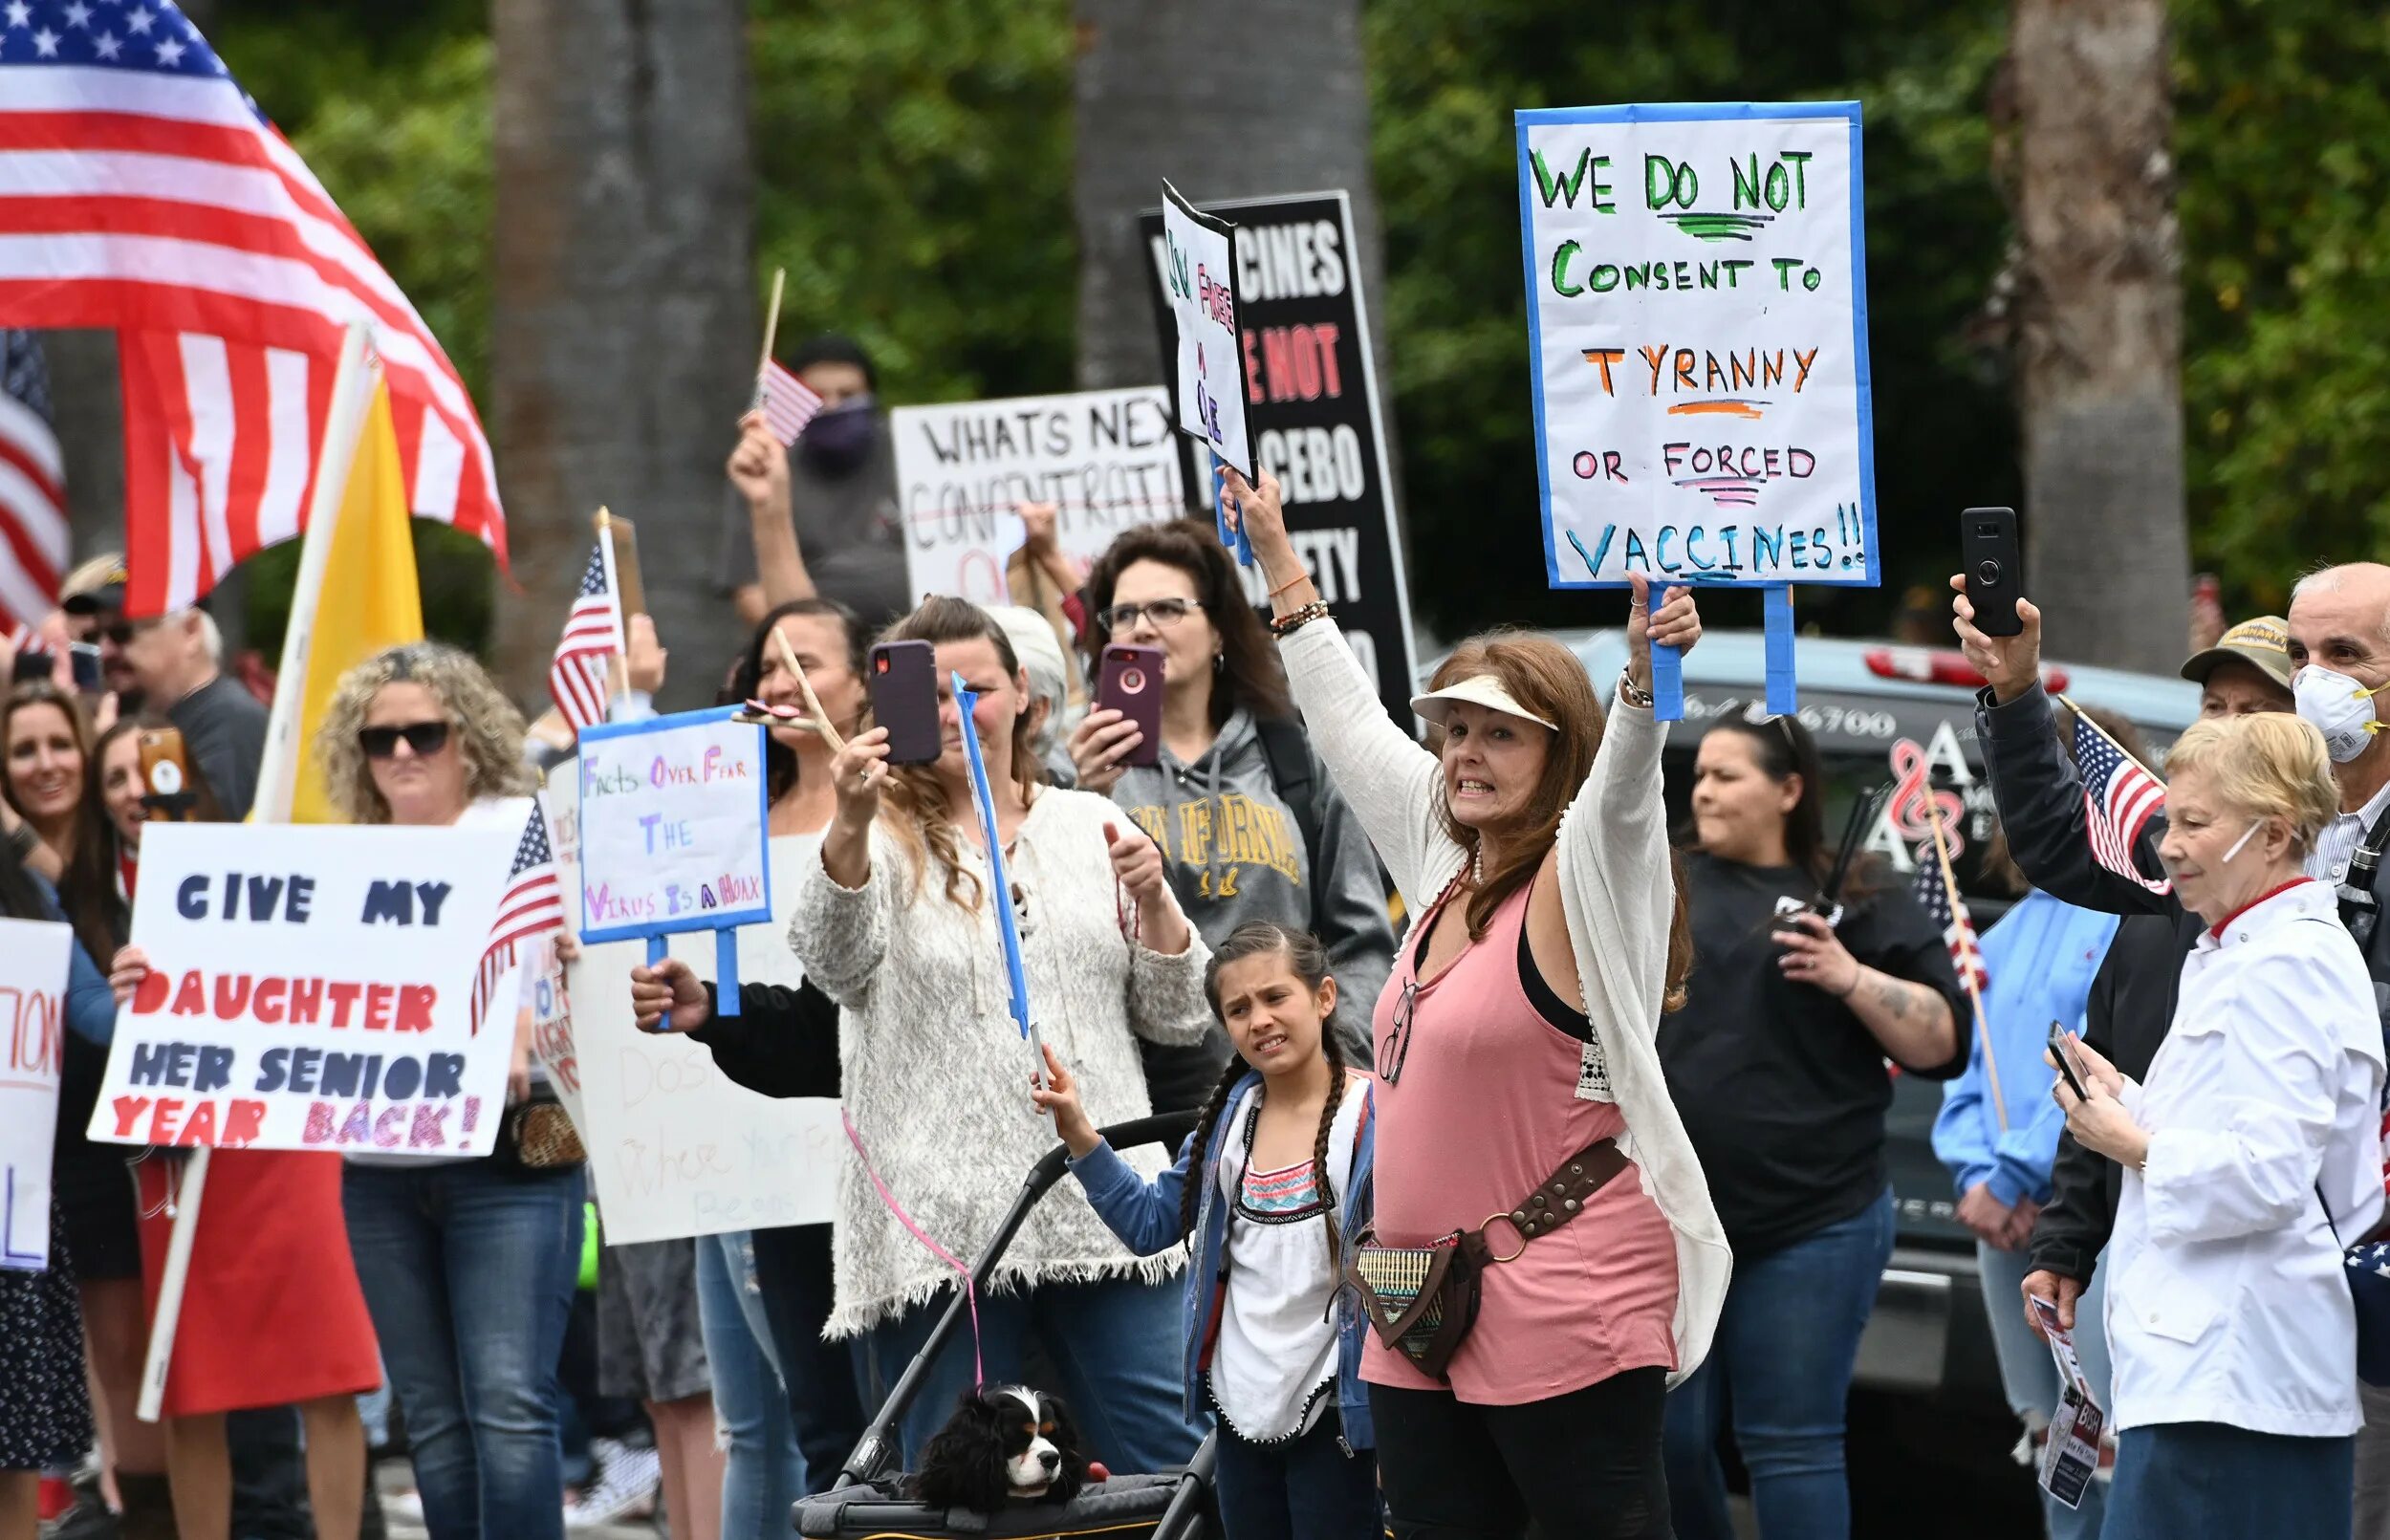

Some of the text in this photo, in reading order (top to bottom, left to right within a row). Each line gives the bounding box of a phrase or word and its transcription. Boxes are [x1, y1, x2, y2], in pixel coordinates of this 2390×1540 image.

[1529, 147, 1813, 214] WE DO NOT
[1552, 239, 1755, 297] CONSENT
[1261, 321, 1342, 403] NOT
[1581, 343, 1818, 398] TYRANNY
[921, 410, 1071, 465] WHATS
[1573, 442, 1816, 484] OR FORCED
[1566, 502, 1866, 579] VACCINES!!
[176, 871, 453, 927] GIVE MY
[701, 882, 718, 910] A
[131, 967, 438, 1033] DAUGHTER
[128, 1041, 467, 1101] HER SENIOR
[112, 1094, 482, 1150] YEAR BACK!
